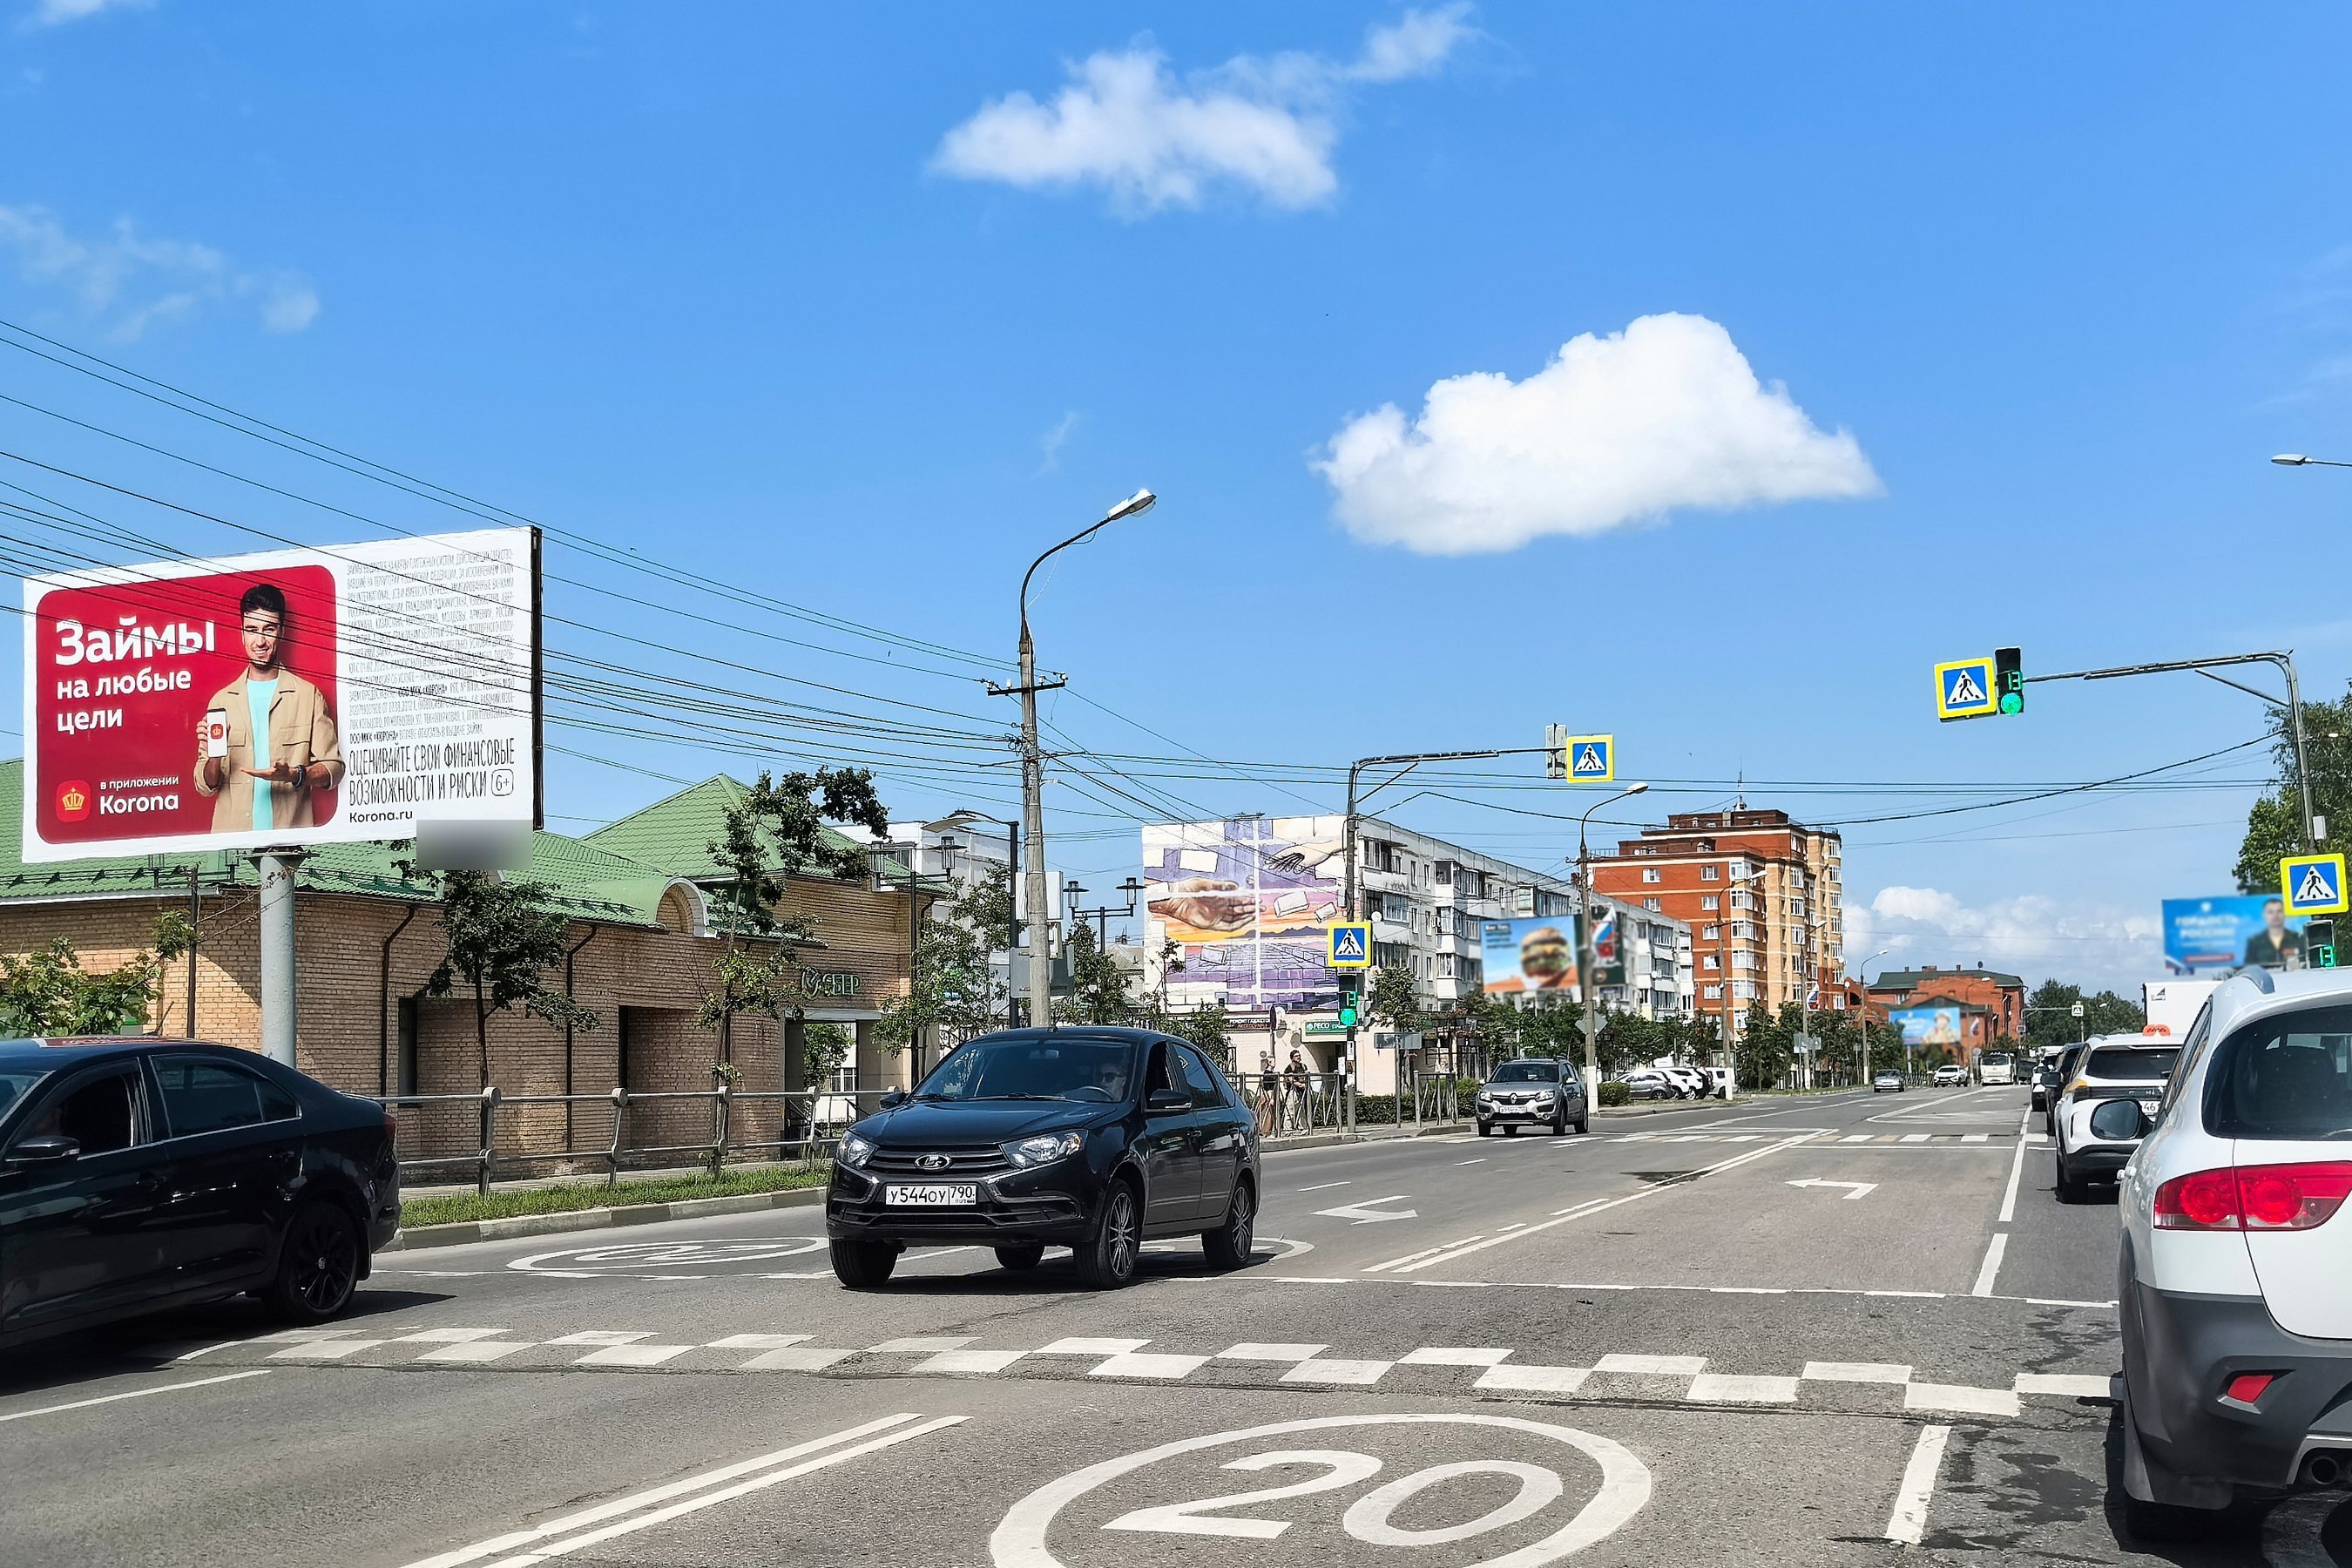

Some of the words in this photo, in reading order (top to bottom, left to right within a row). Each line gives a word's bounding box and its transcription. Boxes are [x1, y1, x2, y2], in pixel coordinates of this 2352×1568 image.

[55, 615, 215, 666] Займы
[57, 678, 90, 700] на
[95, 666, 192, 697] любые
[2008, 671, 2023, 691] 13
[57, 707, 123, 735] цели
[349, 742, 410, 779] ОЦЕНИВАЙТЕ
[414, 744, 441, 771] СВОИ
[444, 737, 515, 768] ФИНАНСОВЫЕ
[100, 781, 107, 790] в
[109, 775, 179, 791] приложении
[349, 774, 434, 806] ВОЗМОЖНОСТИ
[438, 774, 445, 800] И
[449, 770, 487, 800] РИСКИ
[496, 774, 510, 791] 6+
[99, 794, 179, 815] Korona
[349, 811, 413, 823] Korona.ru
[2320, 946, 2334, 967] 13
[1346, 990, 1356, 1006] 13
[950, 1186, 973, 1199] 790
[1100, 1449, 1564, 1546] 20
